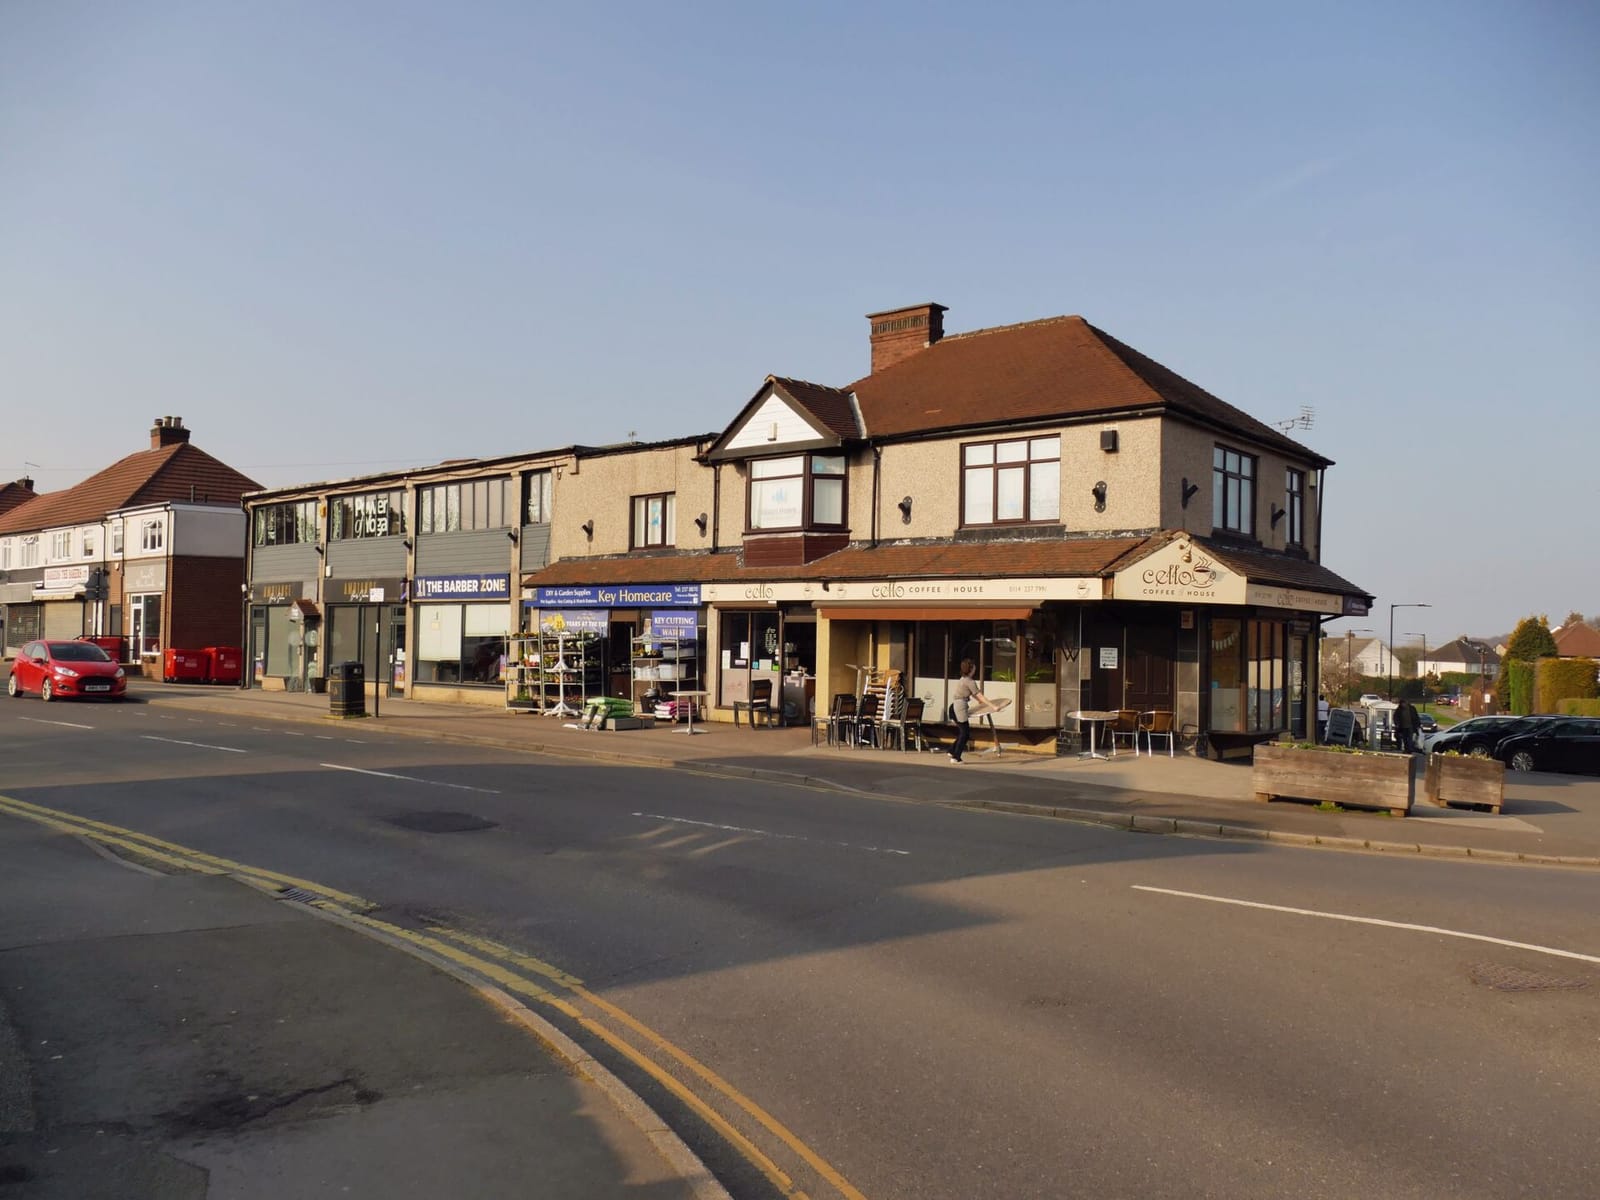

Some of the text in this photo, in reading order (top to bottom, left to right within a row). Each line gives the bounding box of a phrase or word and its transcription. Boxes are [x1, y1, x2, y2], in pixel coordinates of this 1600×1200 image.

[354, 497, 388, 516] Power
[366, 516, 388, 536] Yoga
[1142, 564, 1192, 587] cello
[426, 578, 506, 593] THE BARBER ZONE
[745, 582, 774, 599] cello
[872, 579, 904, 598] cello
[954, 585, 984, 593] HOUSE
[1143, 588, 1175, 596] COFFEE
[598, 589, 672, 605] Key Homecare
[654, 616, 694, 625] KEY CUTTING
